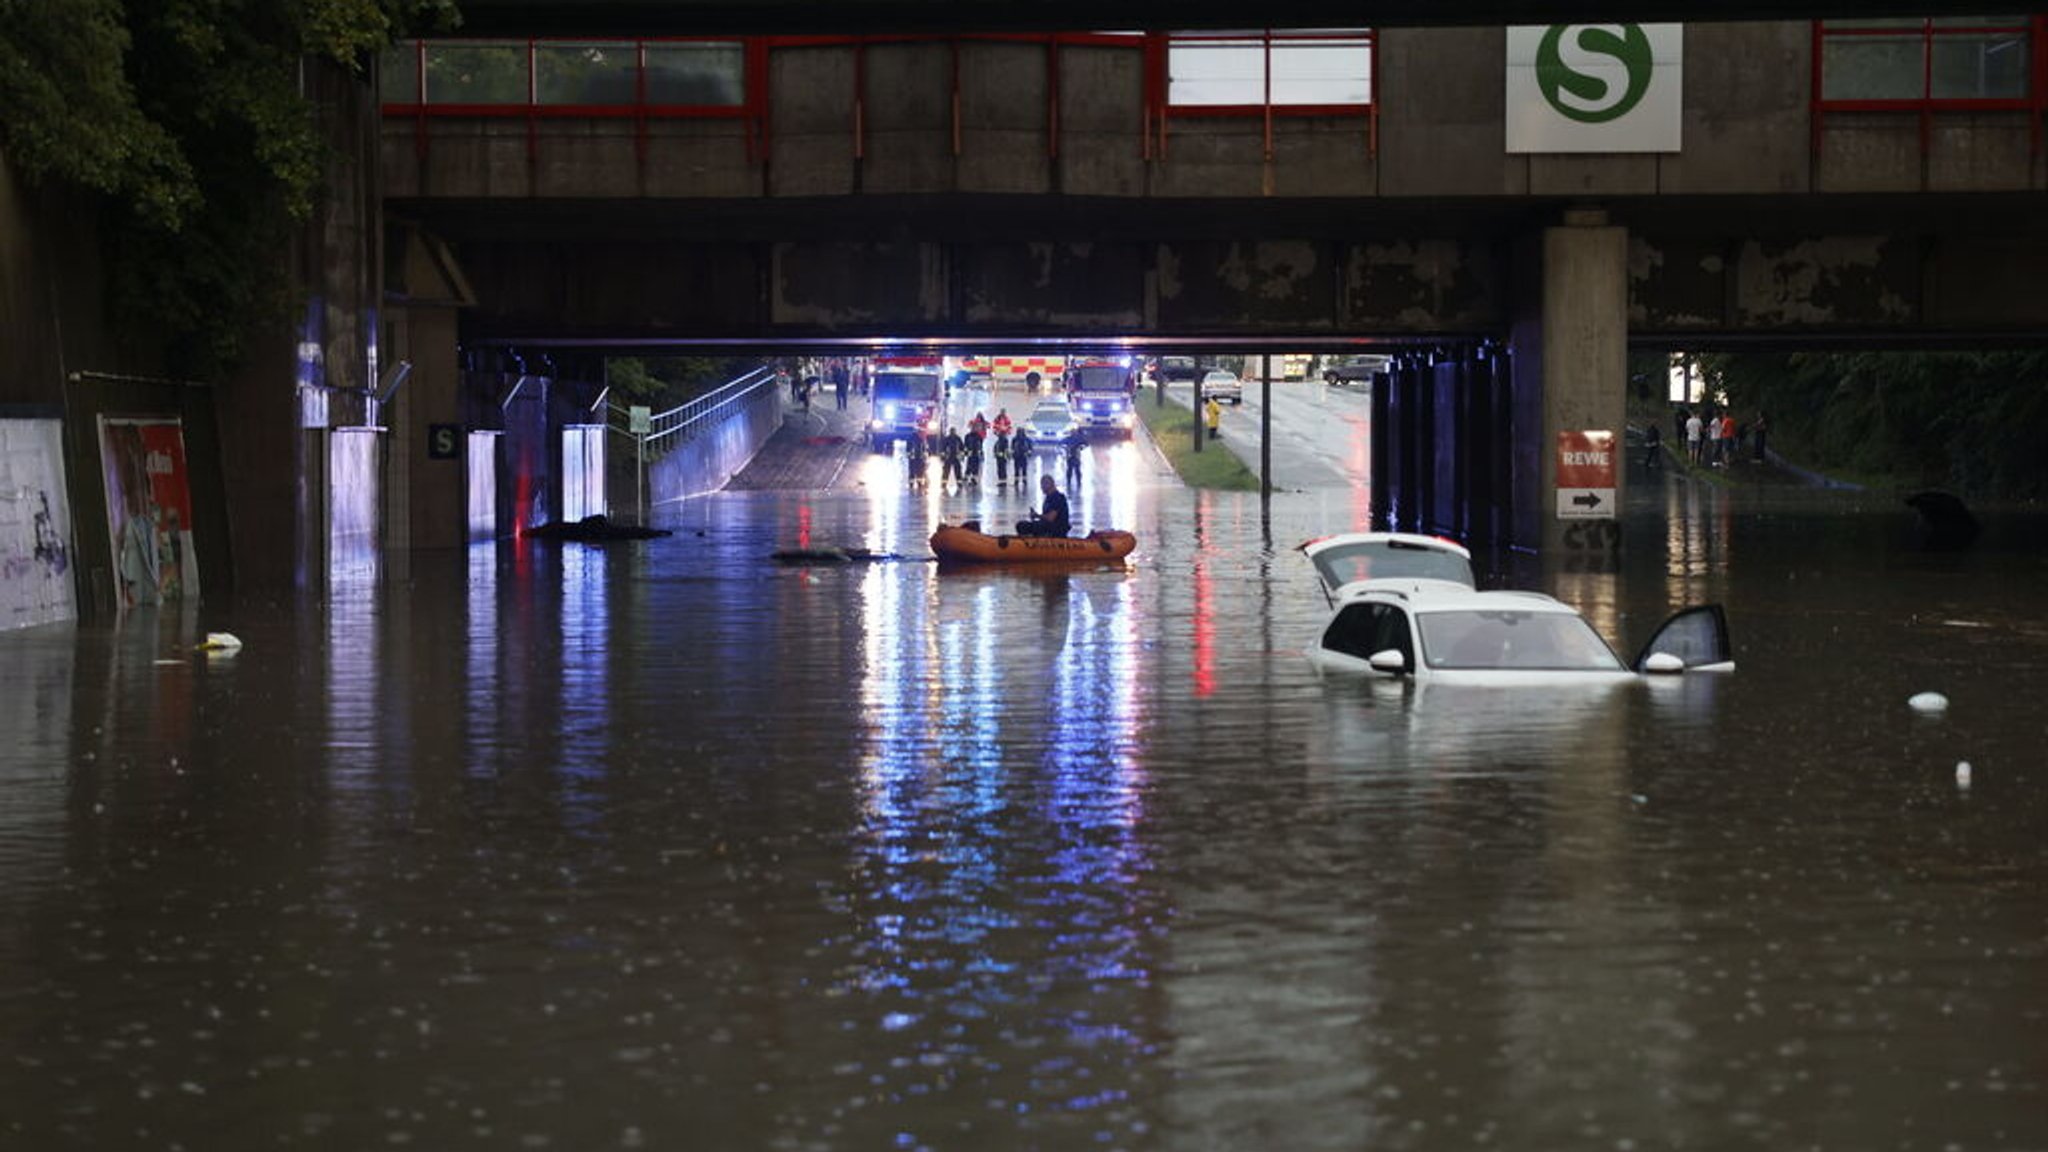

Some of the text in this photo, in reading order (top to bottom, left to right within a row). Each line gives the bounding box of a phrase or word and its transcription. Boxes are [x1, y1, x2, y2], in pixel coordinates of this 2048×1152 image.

[1558, 24, 1630, 112] S
[436, 428, 453, 453] S
[1562, 451, 1610, 466] REWE
